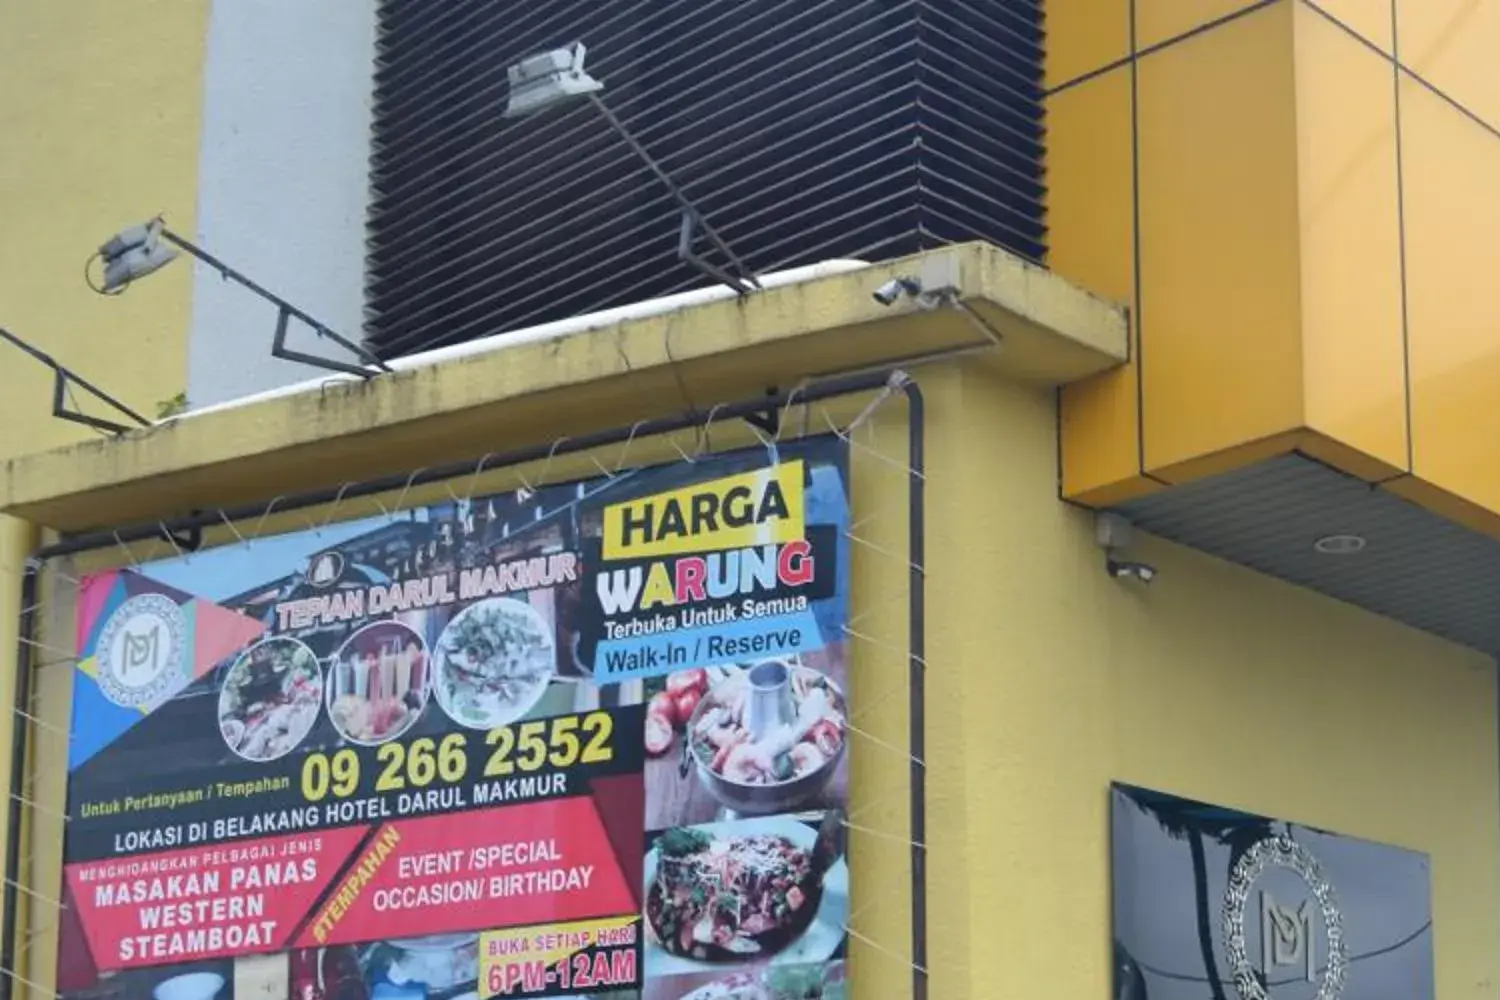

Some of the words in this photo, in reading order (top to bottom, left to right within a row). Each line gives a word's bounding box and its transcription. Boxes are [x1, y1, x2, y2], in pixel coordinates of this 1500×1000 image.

[621, 480, 789, 546] HARGA
[277, 590, 363, 630] TEPIAN
[369, 574, 454, 615] DARUL
[460, 551, 577, 599] MAKMUR
[597, 541, 814, 615] WARUNG
[604, 616, 675, 640] Terbuka
[681, 604, 737, 628] Untuk
[742, 594, 808, 619] Semua
[605, 643, 686, 674] Walk-In
[693, 637, 701, 658] /
[708, 627, 801, 659] Reserve
[81, 801, 120, 818] Untuk
[124, 788, 202, 813] Pertanyaan
[216, 777, 290, 799] Tempahan
[302, 750, 360, 800] 09
[376, 734, 467, 791] 266
[484, 712, 613, 776] 2552
[115, 826, 182, 852] LOKASI
[189, 823, 207, 841] DI
[213, 805, 319, 839] BELAKANG
[327, 796, 390, 824] HOTEL
[397, 786, 465, 815] DARUL
[473, 773, 566, 804] MAKMUR
[79, 856, 200, 881] MENGHIDANGKAN
[203, 845, 276, 866] PELBAGAI
[280, 838, 322, 857] JENIS
[398, 850, 464, 879] EVENT
[490, 865, 594, 898] BIRTHDAY
[95, 871, 219, 908] MASAKAN
[231, 858, 317, 890] PANAS
[140, 894, 264, 929] WESTERN
[120, 921, 277, 961] STEAMBOAT
[488, 937, 530, 956] BUKA
[535, 931, 590, 951] SETIAP
[596, 924, 637, 945] HARI
[487, 949, 637, 993] 6PM-12AM
